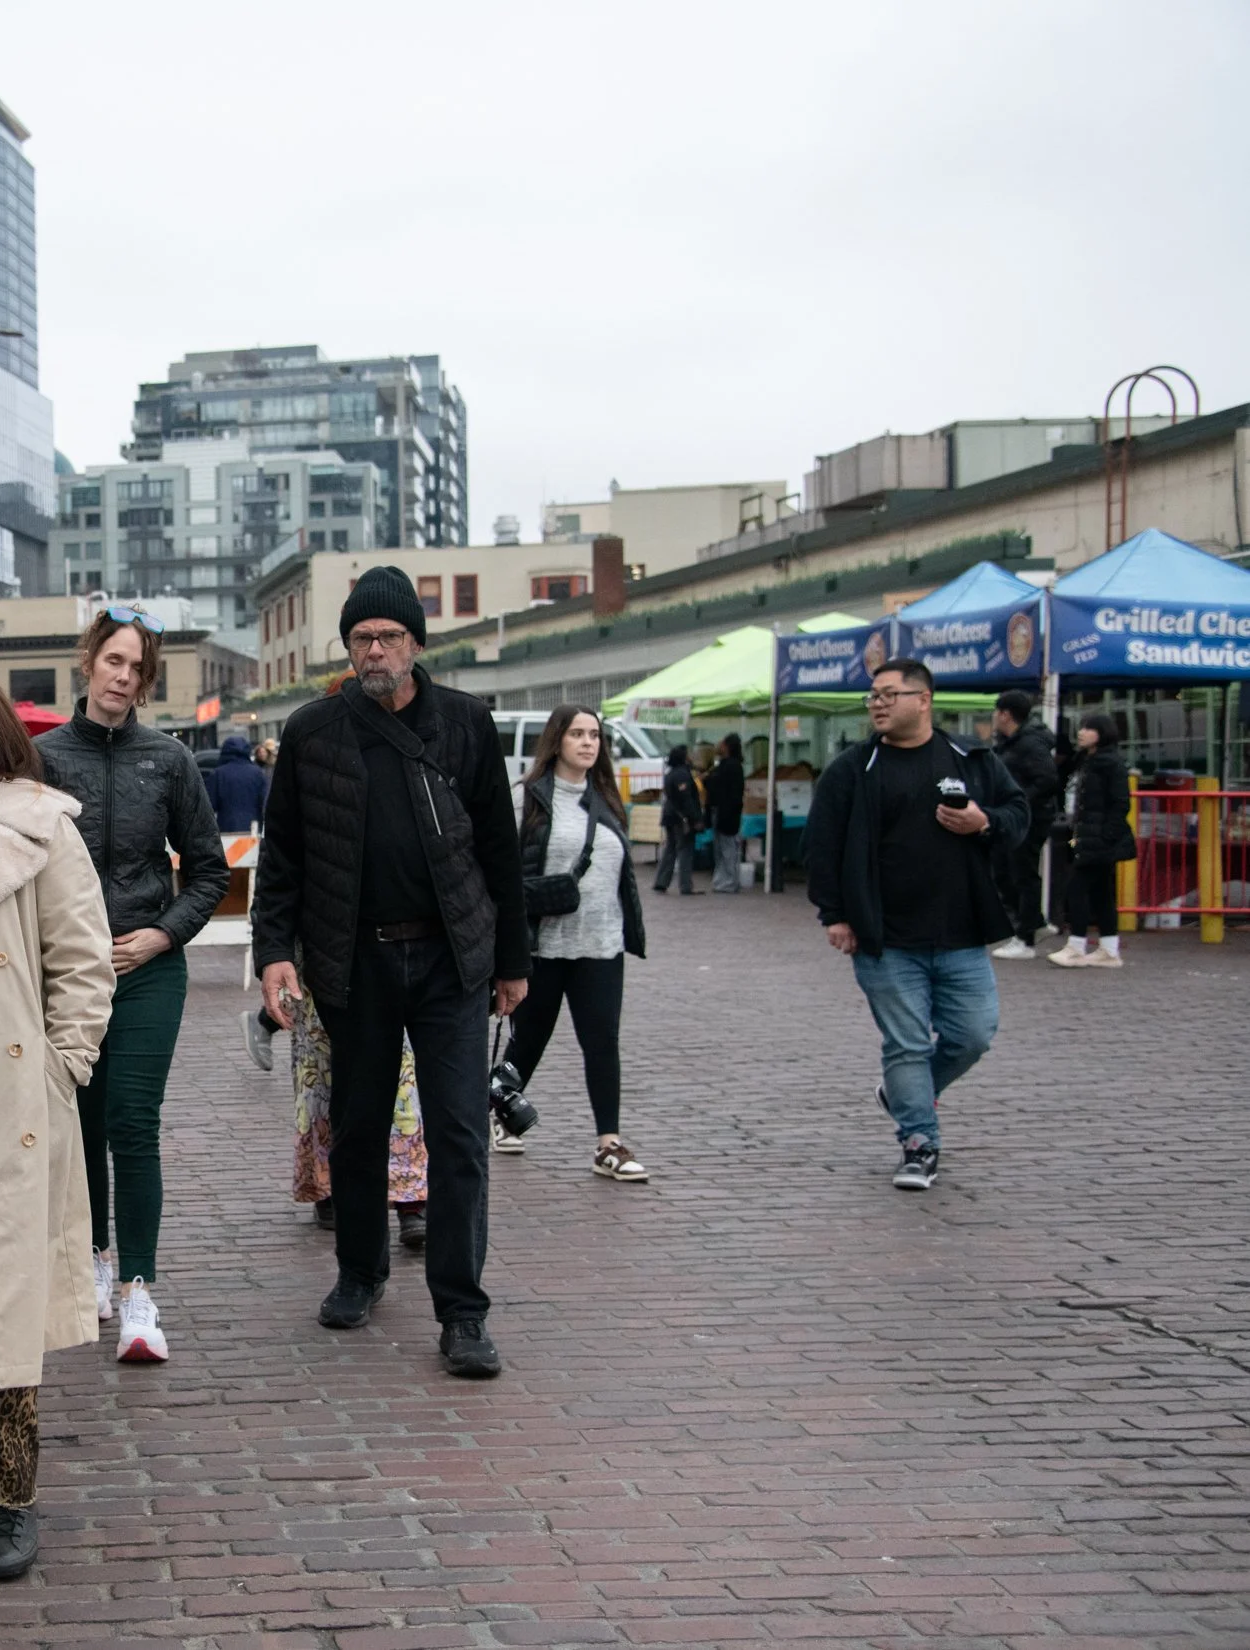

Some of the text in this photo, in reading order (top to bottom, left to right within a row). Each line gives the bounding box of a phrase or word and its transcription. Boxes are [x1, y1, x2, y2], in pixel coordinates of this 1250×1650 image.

[949, 621, 992, 644] Cheese
[1095, 607, 1196, 635] Grilled
[1062, 633, 1101, 653] GRASS
[922, 647, 980, 673] Sandwich
[1074, 648, 1099, 664] FED
